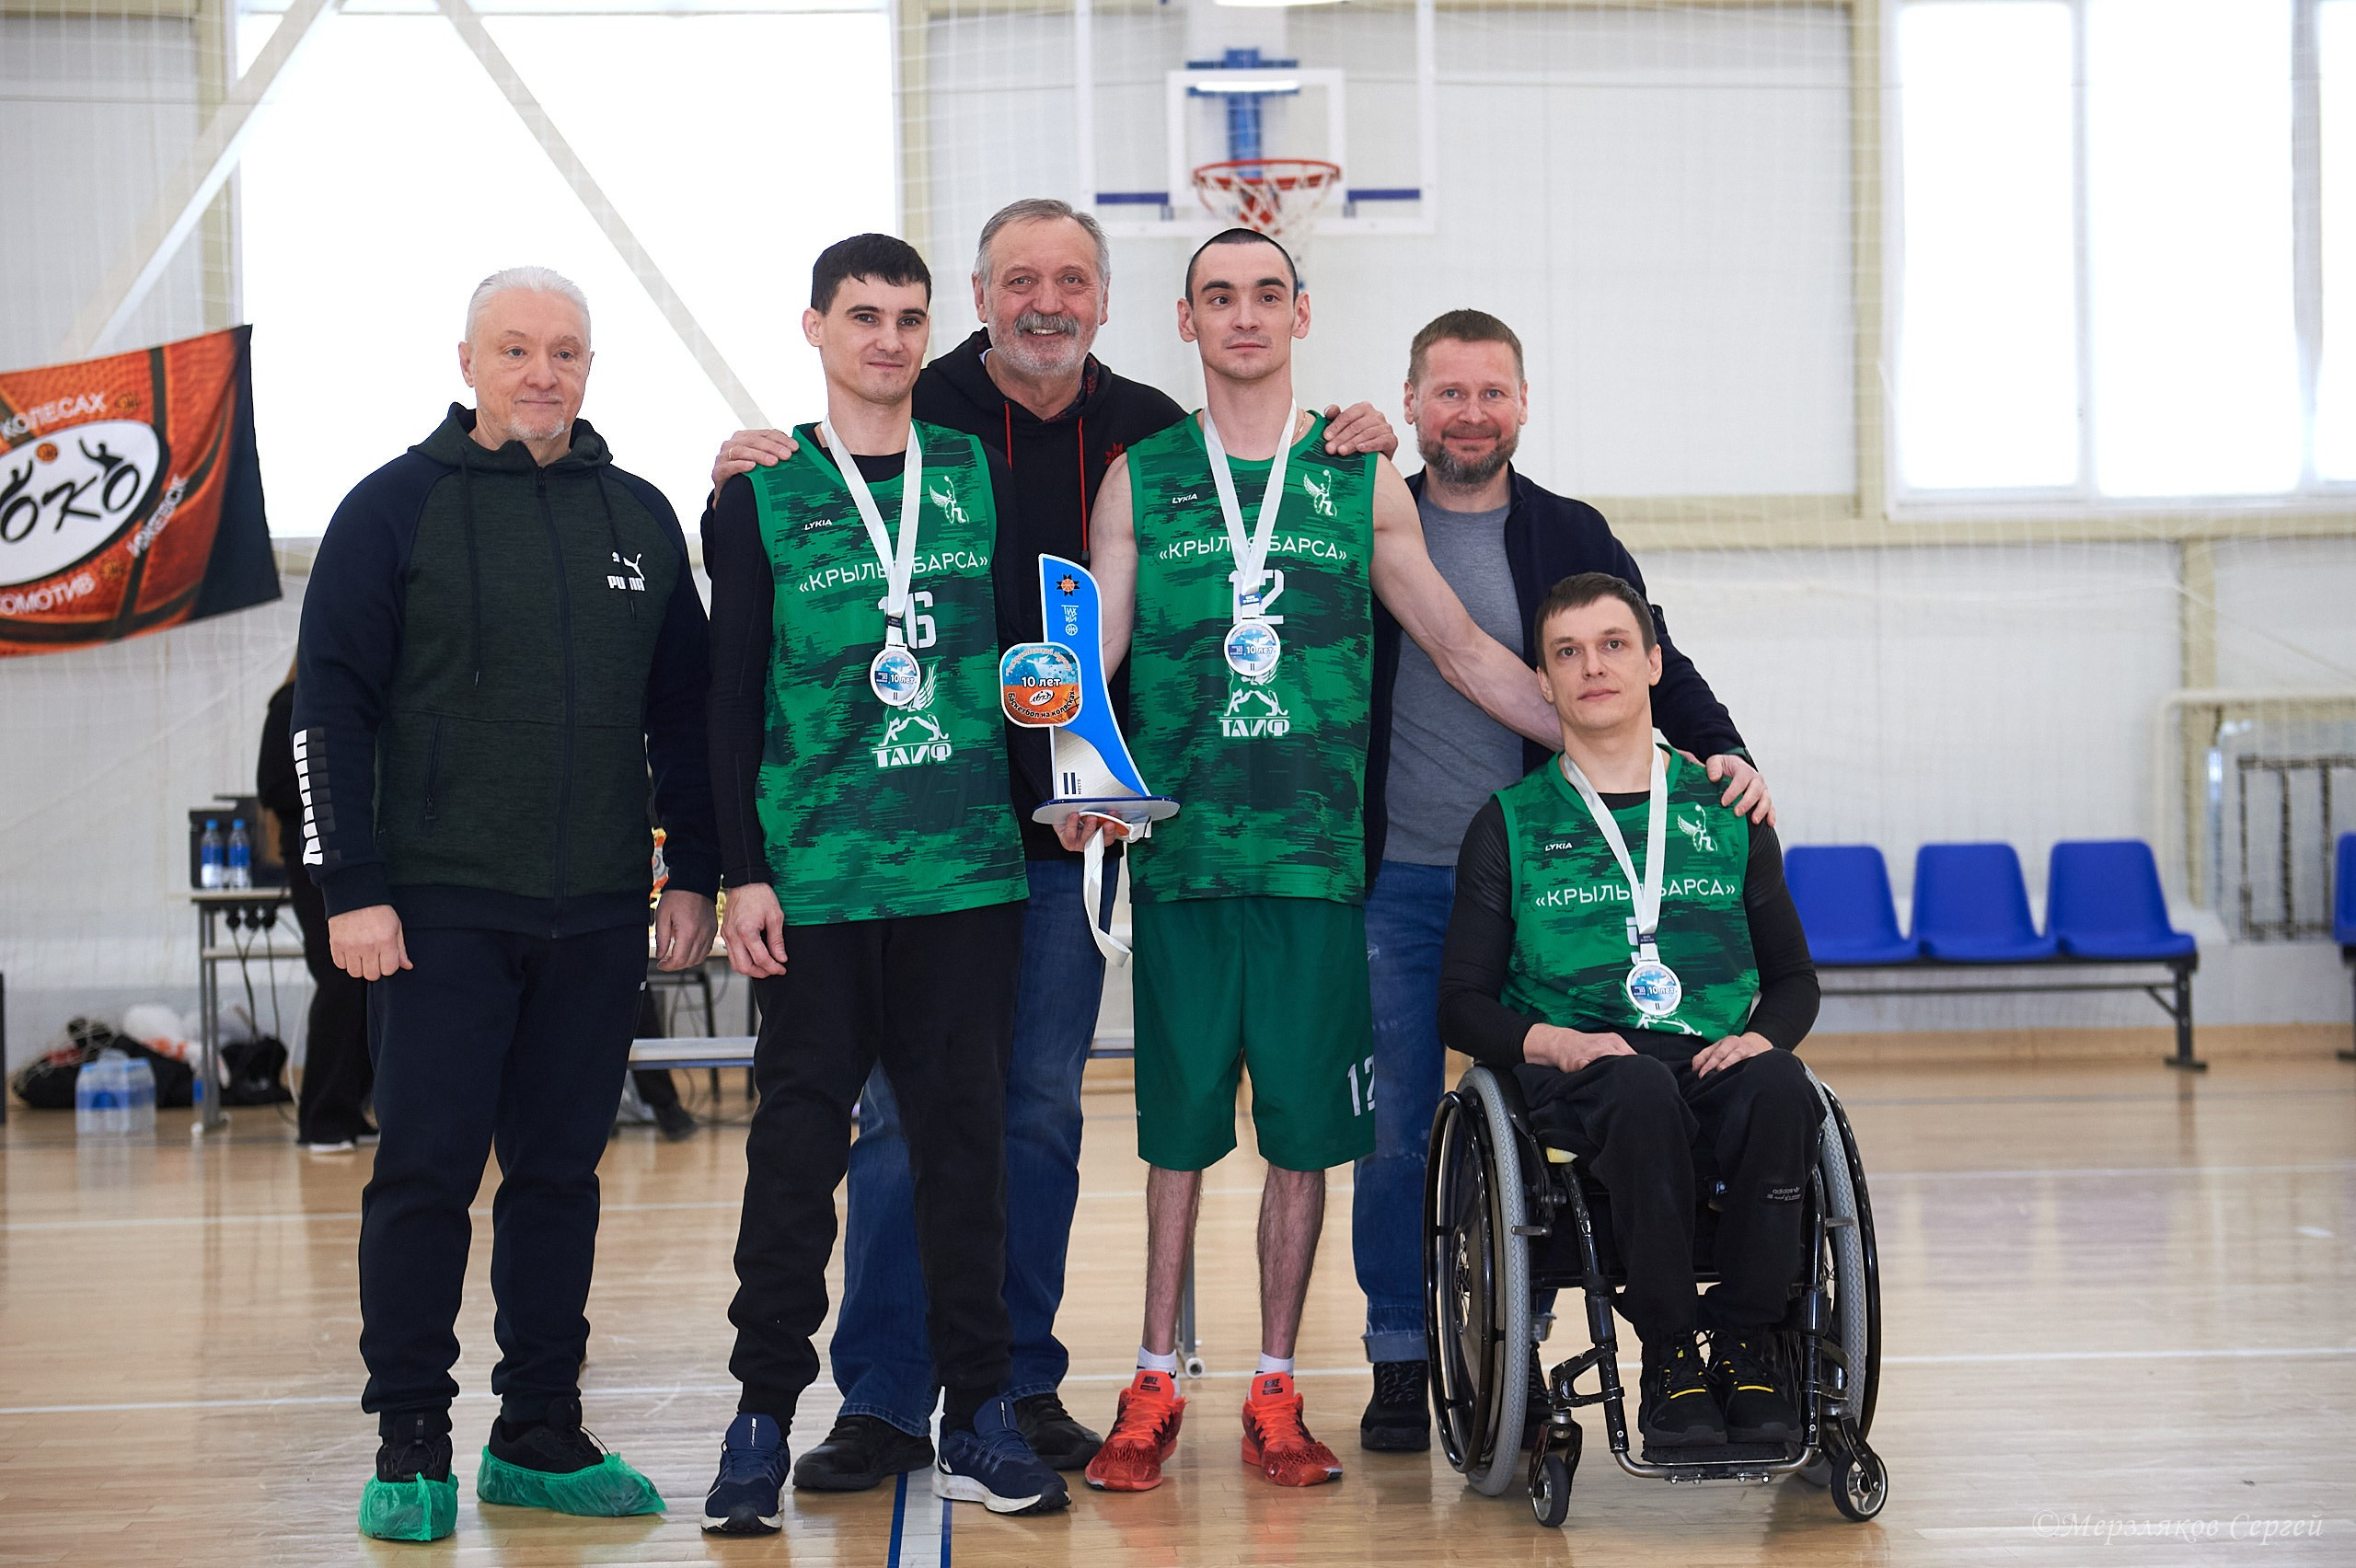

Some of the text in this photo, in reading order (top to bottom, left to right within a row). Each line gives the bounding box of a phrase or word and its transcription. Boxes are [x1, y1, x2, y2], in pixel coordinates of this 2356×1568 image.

[2, 391, 107, 440] КОЛЕСАХ
[1172, 492, 1198, 504] LYKIA
[804, 518, 833, 531] LYKIA
[798, 551, 988, 594] «КРЫЛЬ БАРСА»
[0, 572, 96, 616] ОМОТИВ
[1246, 646, 1256, 654] 10
[890, 674, 899, 683] 10
[1022, 676, 1061, 688] 10 лет
[1218, 719, 1290, 737] ТАИФ
[872, 742, 953, 768] ТАИФ
[1544, 842, 1573, 852] LYKIA
[1535, 882, 1644, 906] «КРЫЛЬ
[1648, 986, 1658, 995] 10
